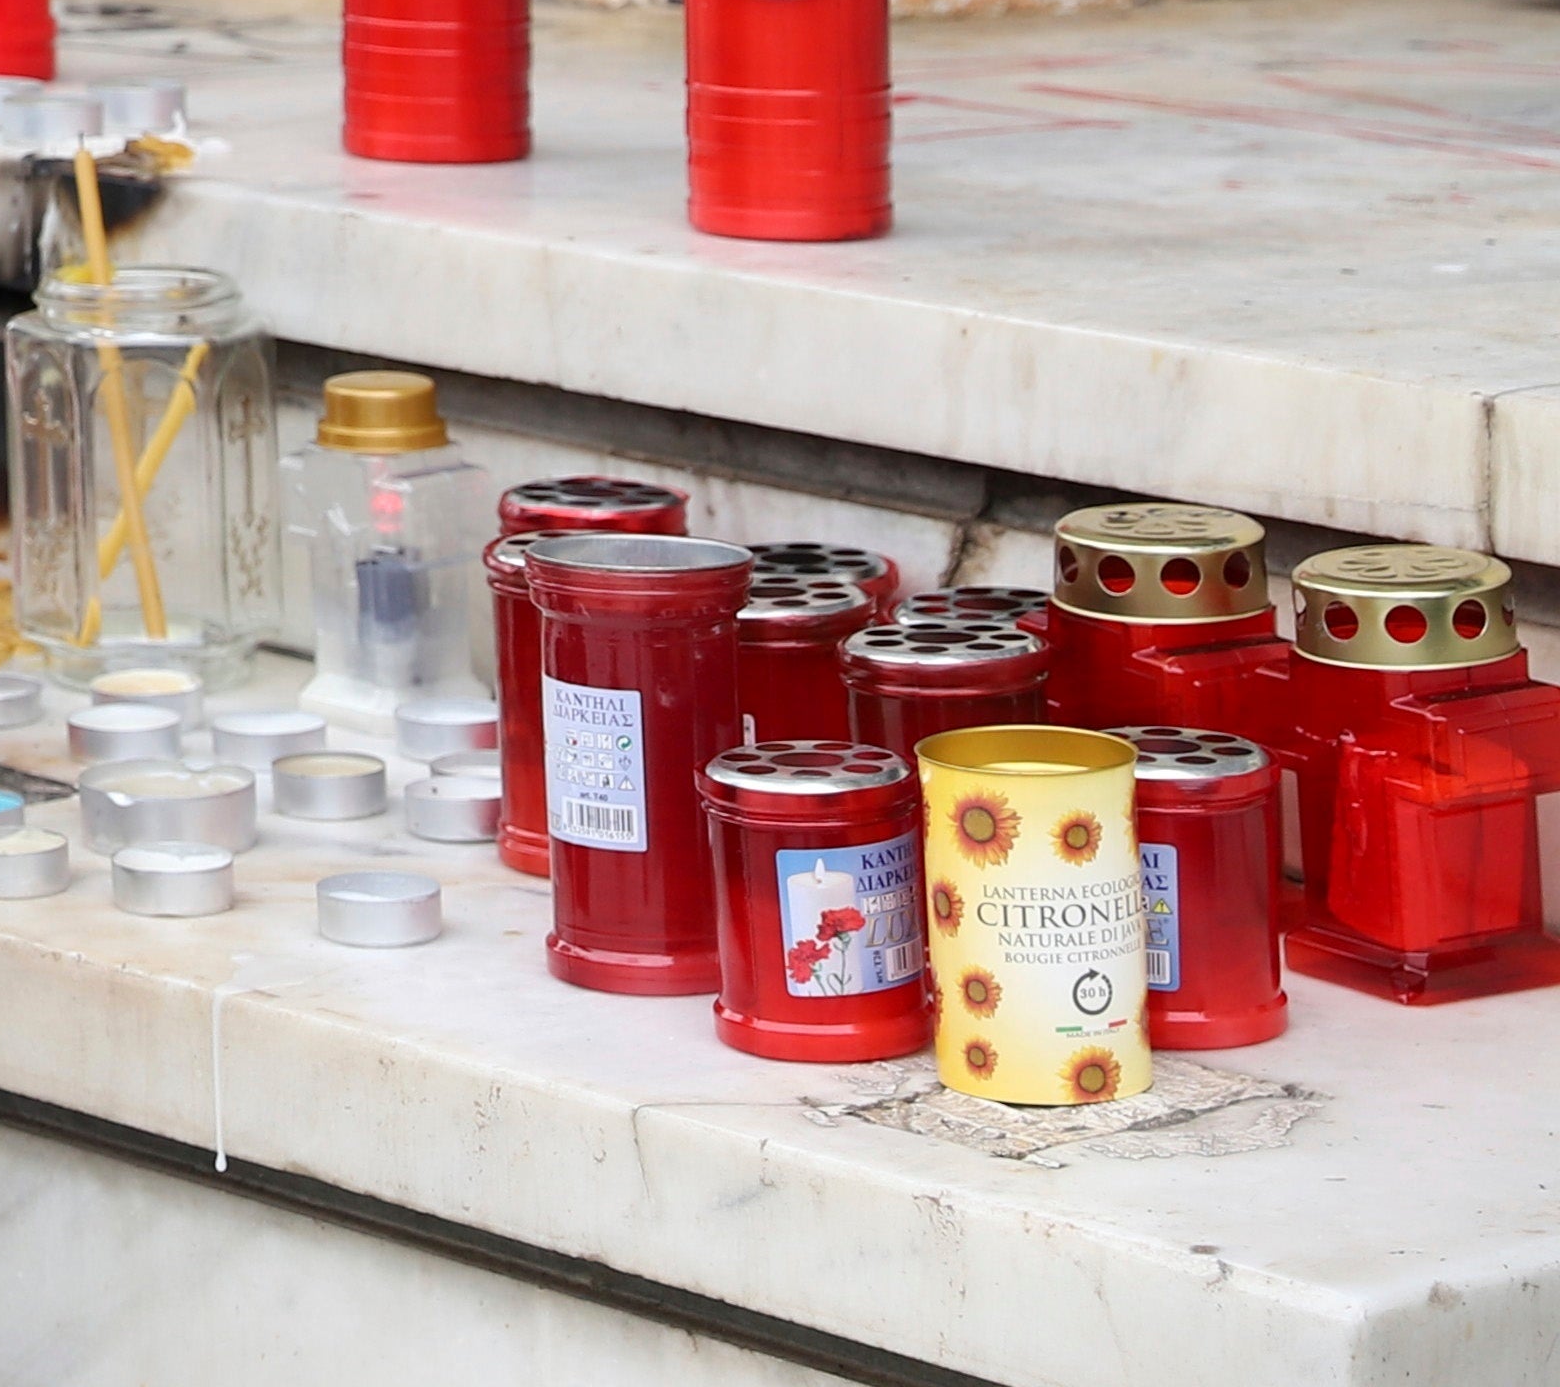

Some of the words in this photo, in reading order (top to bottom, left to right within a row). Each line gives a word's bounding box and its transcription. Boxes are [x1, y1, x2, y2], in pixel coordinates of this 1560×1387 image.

[555, 688, 625, 713] ΚΑΝΤΗΛΙ
[553, 704, 635, 727] ΔΙΑΡΚΕΙΑΣ
[982, 883, 1077, 901] LANTERNA
[998, 930, 1096, 949] NATURALE
[1101, 927, 1119, 944] DI
[1004, 951, 1063, 964] BOUGIE
[1079, 987, 1096, 999] 30
[1097, 984, 1107, 998] h
